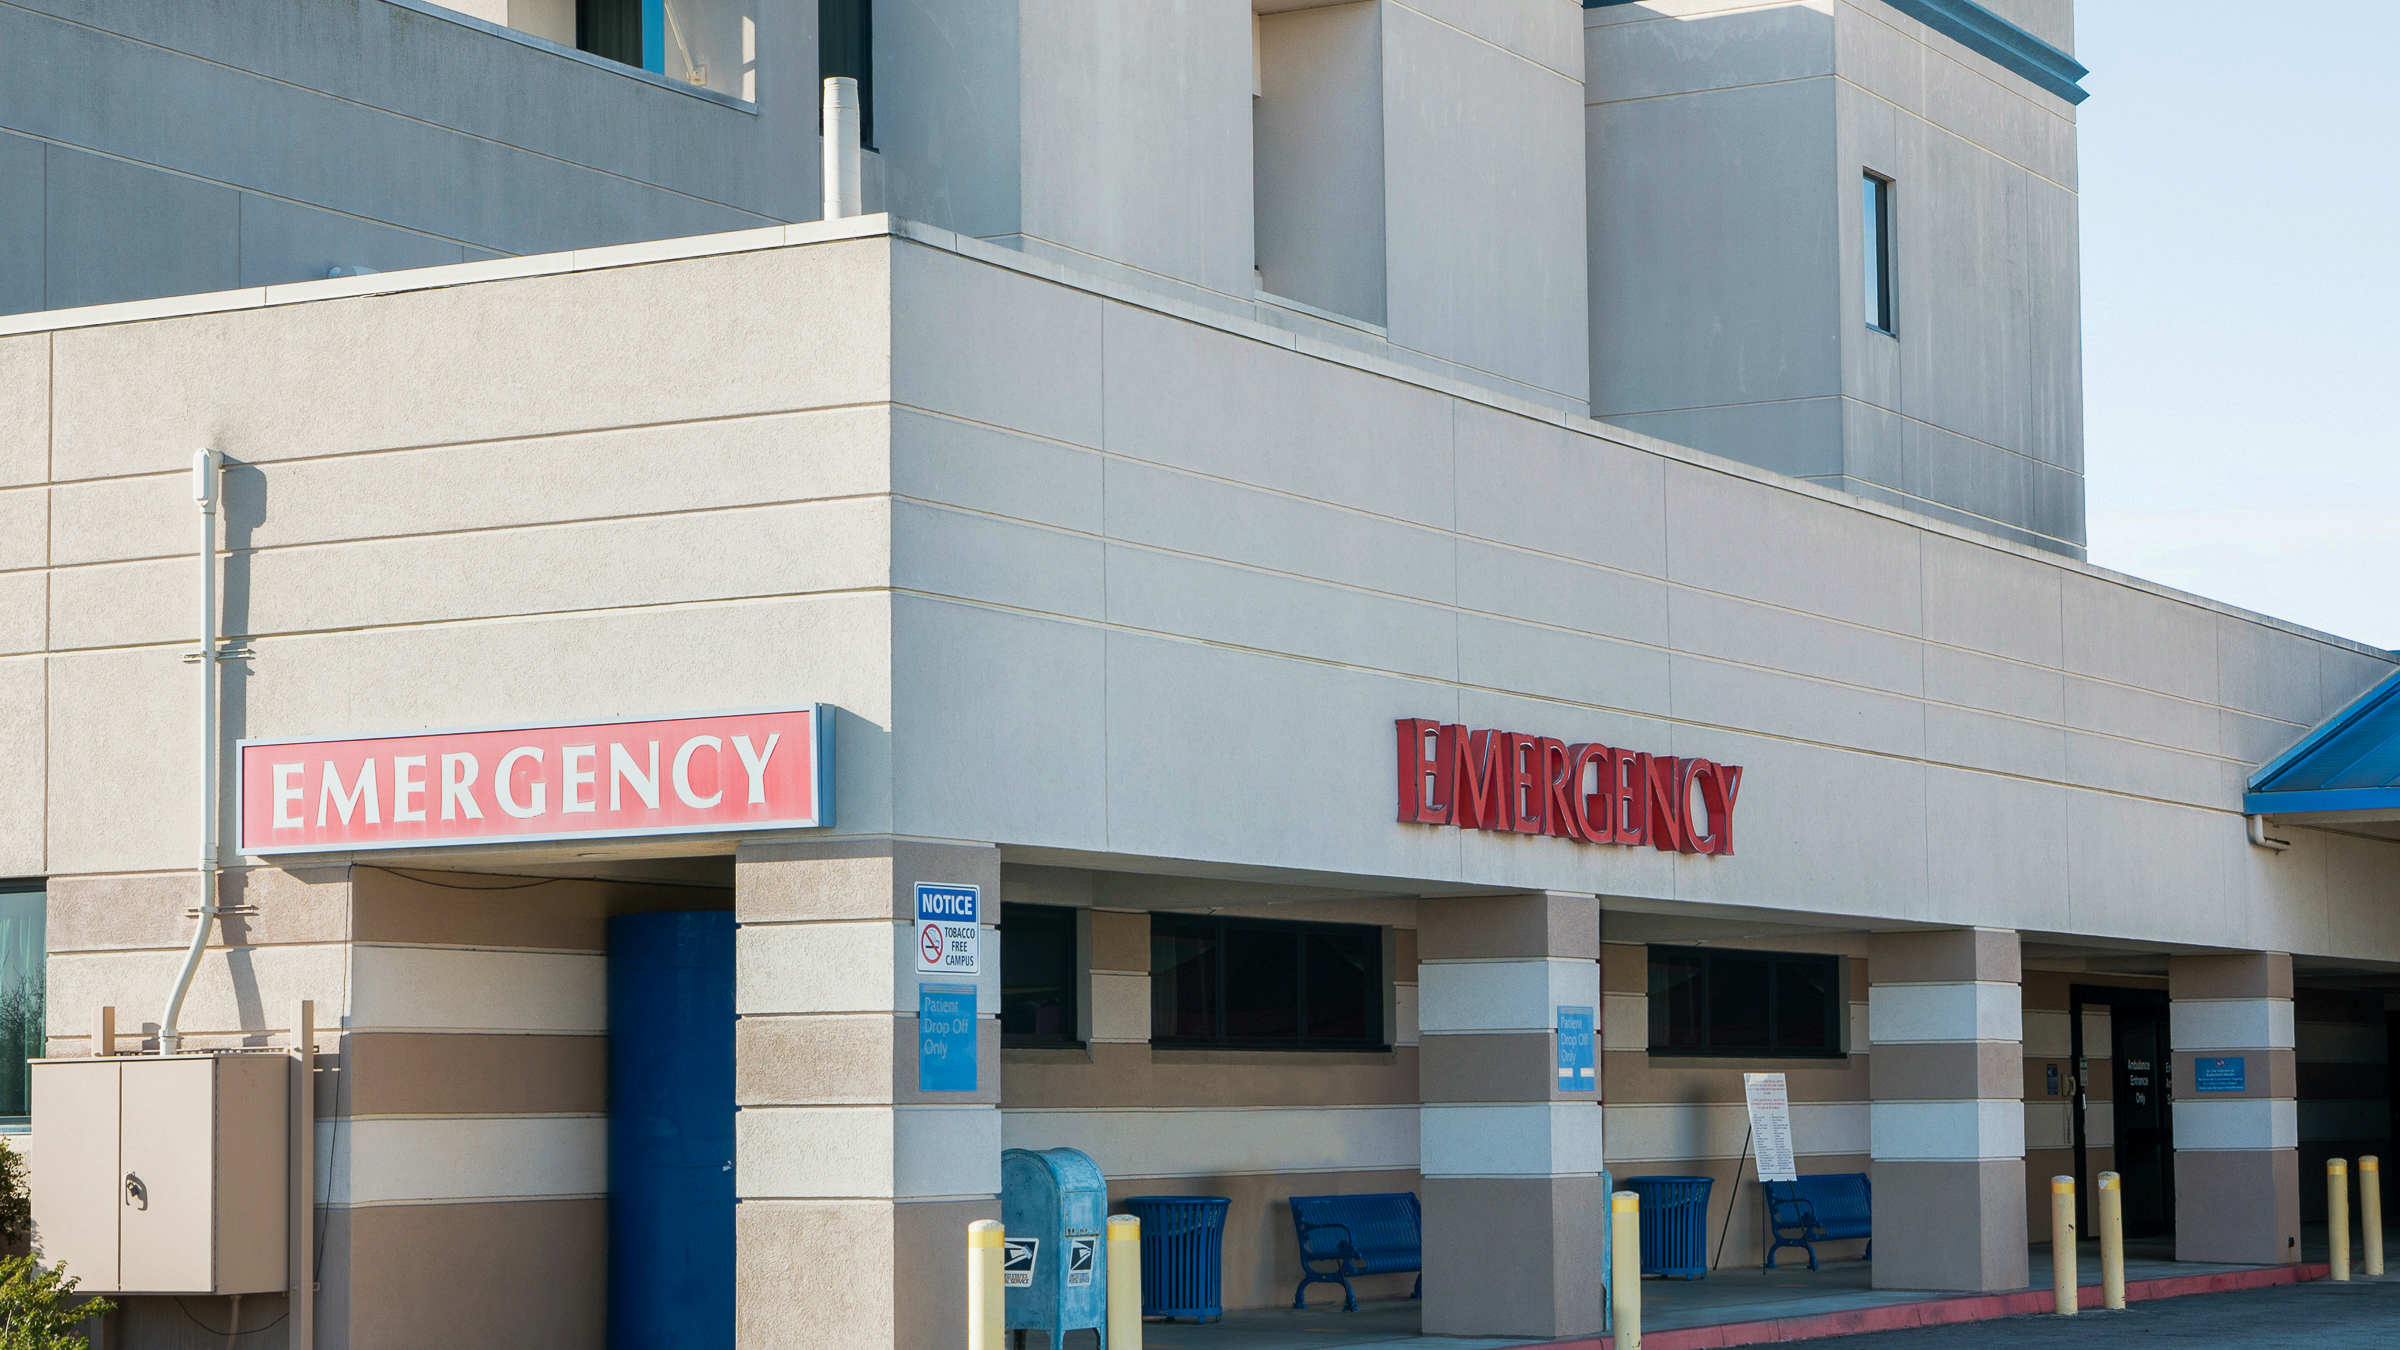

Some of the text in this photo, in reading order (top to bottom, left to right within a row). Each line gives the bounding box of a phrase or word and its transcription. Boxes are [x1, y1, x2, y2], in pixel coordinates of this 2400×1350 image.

[271, 732, 781, 830] EMERGENCY
[1395, 718, 1743, 855] EMERGENCY
[922, 893, 973, 915] NOTICE
[944, 926, 976, 939] TOBACCO
[951, 940, 968, 952] FREE
[945, 954, 974, 966] CAMPUS
[924, 996, 959, 1013] Patient
[924, 1017, 970, 1037] Drop Off
[1560, 1016, 1583, 1029] Patient
[1560, 1033, 1589, 1048] Drop Off
[924, 1038, 948, 1059] Only
[1560, 1049, 1576, 1065] Only
[2127, 1059, 2151, 1070] Ambulance
[2130, 1074, 2149, 1086] Entrance
[2135, 1092, 2146, 1105] Only
